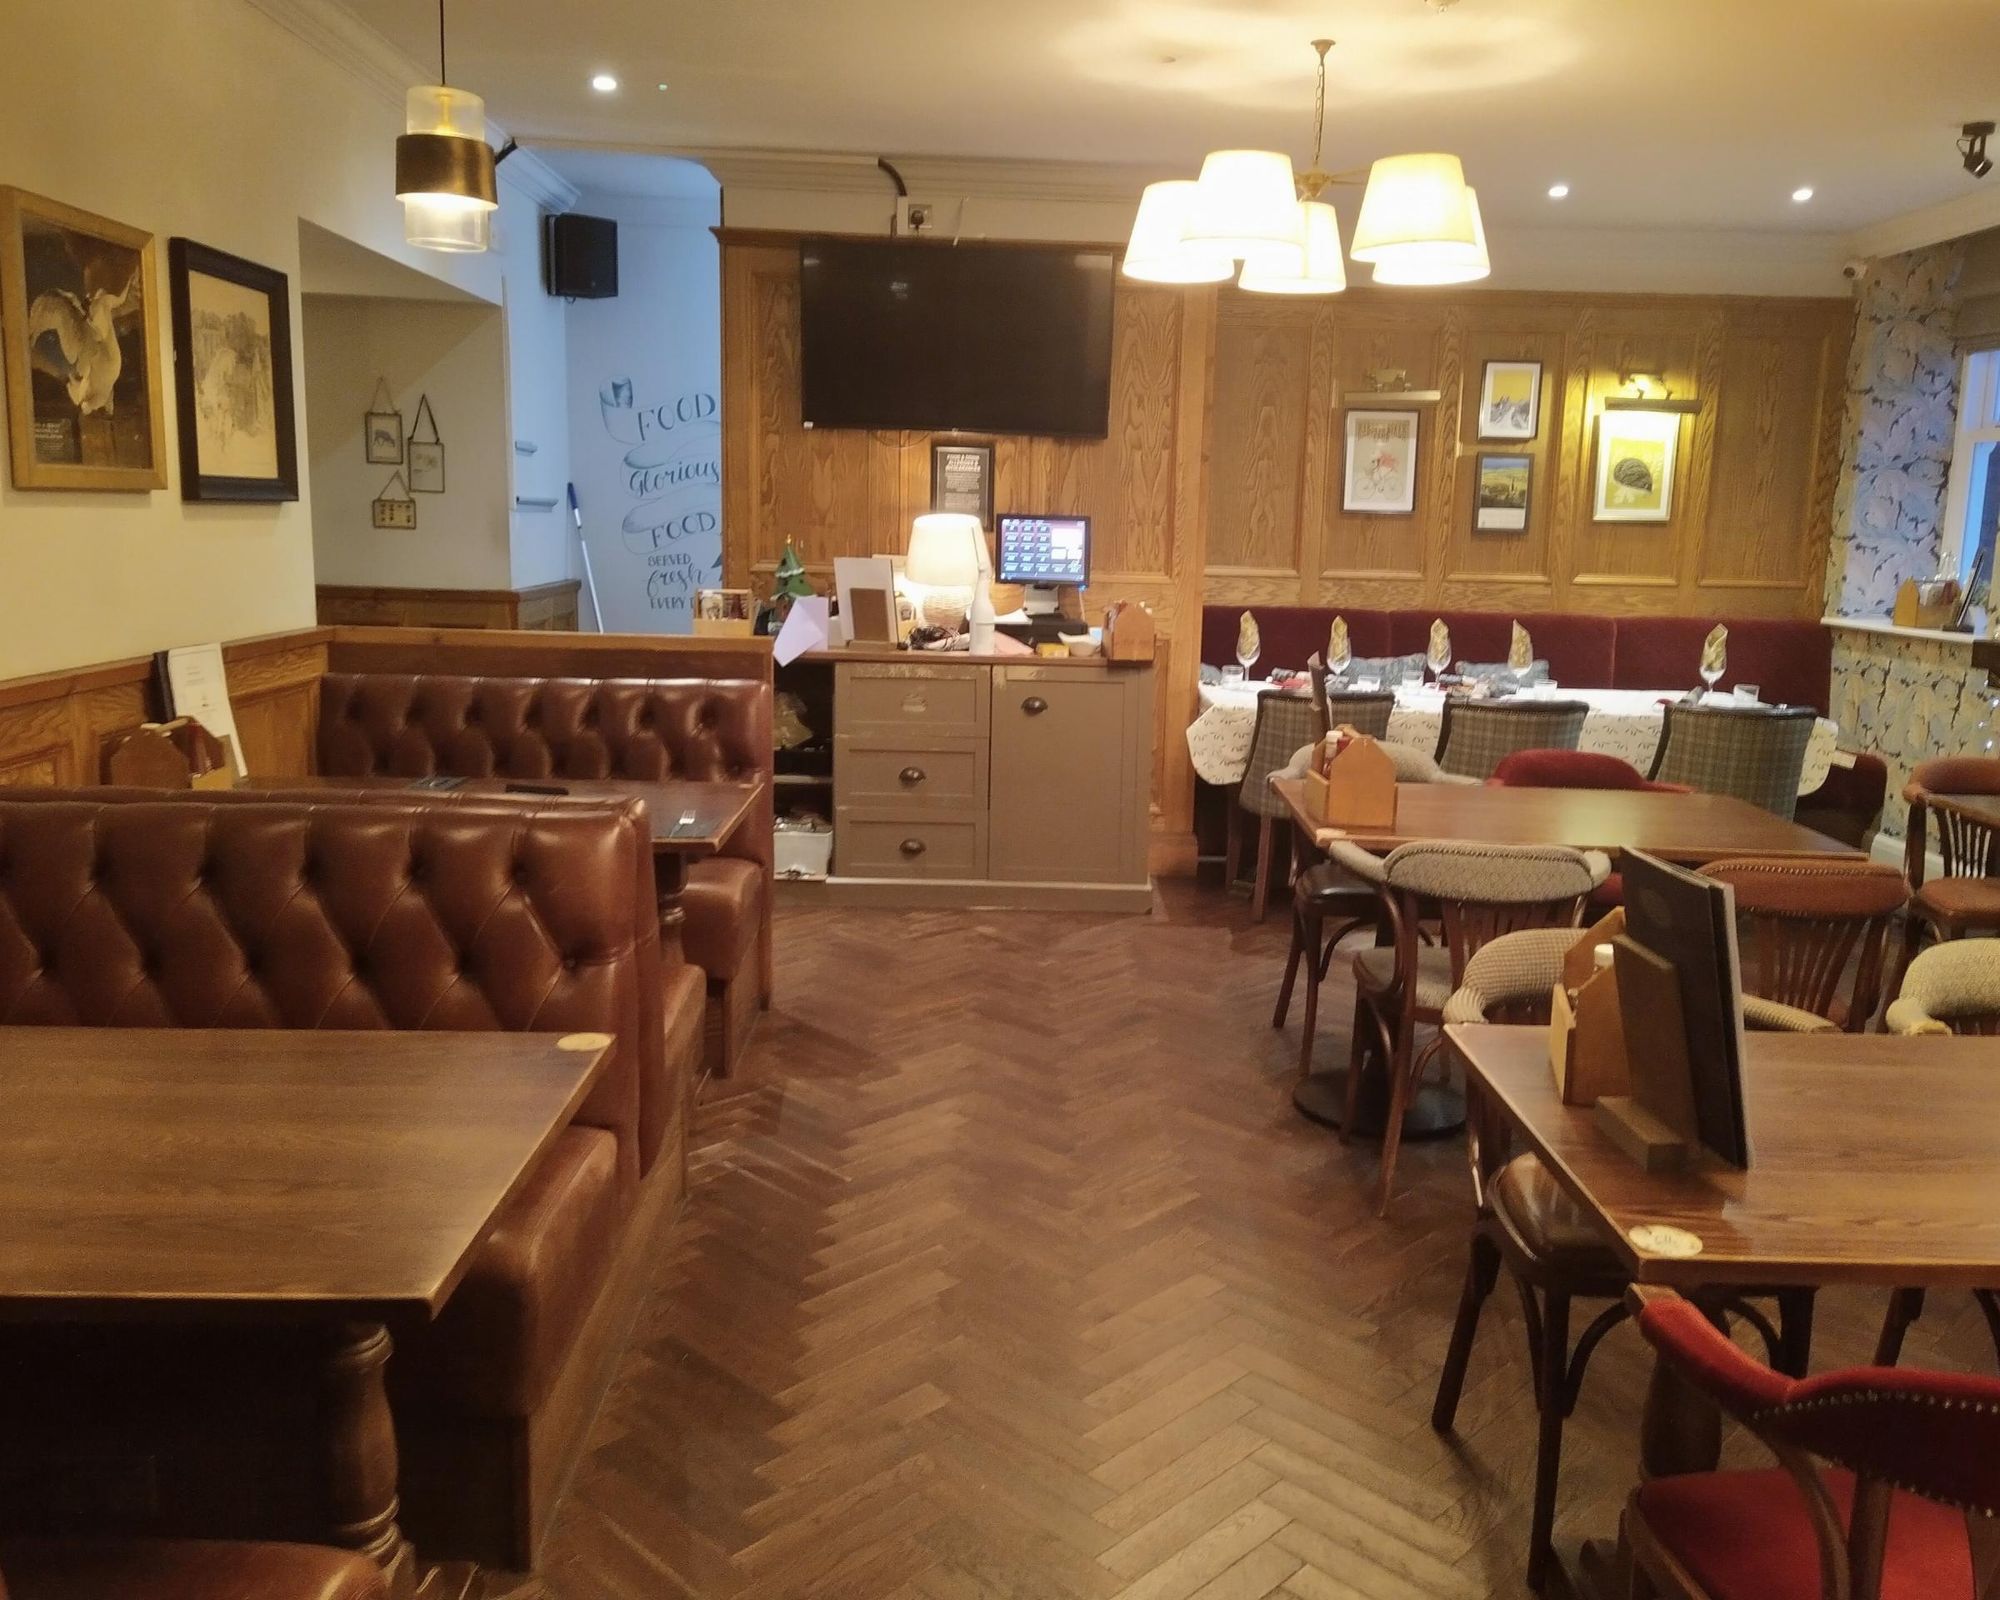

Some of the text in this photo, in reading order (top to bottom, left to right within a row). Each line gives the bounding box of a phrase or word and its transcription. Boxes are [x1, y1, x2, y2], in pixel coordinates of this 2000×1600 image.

[637, 393, 716, 441] FOOD
[629, 461, 720, 497] Glorious
[651, 512, 716, 548] FOOD
[648, 553, 692, 567] SERVED
